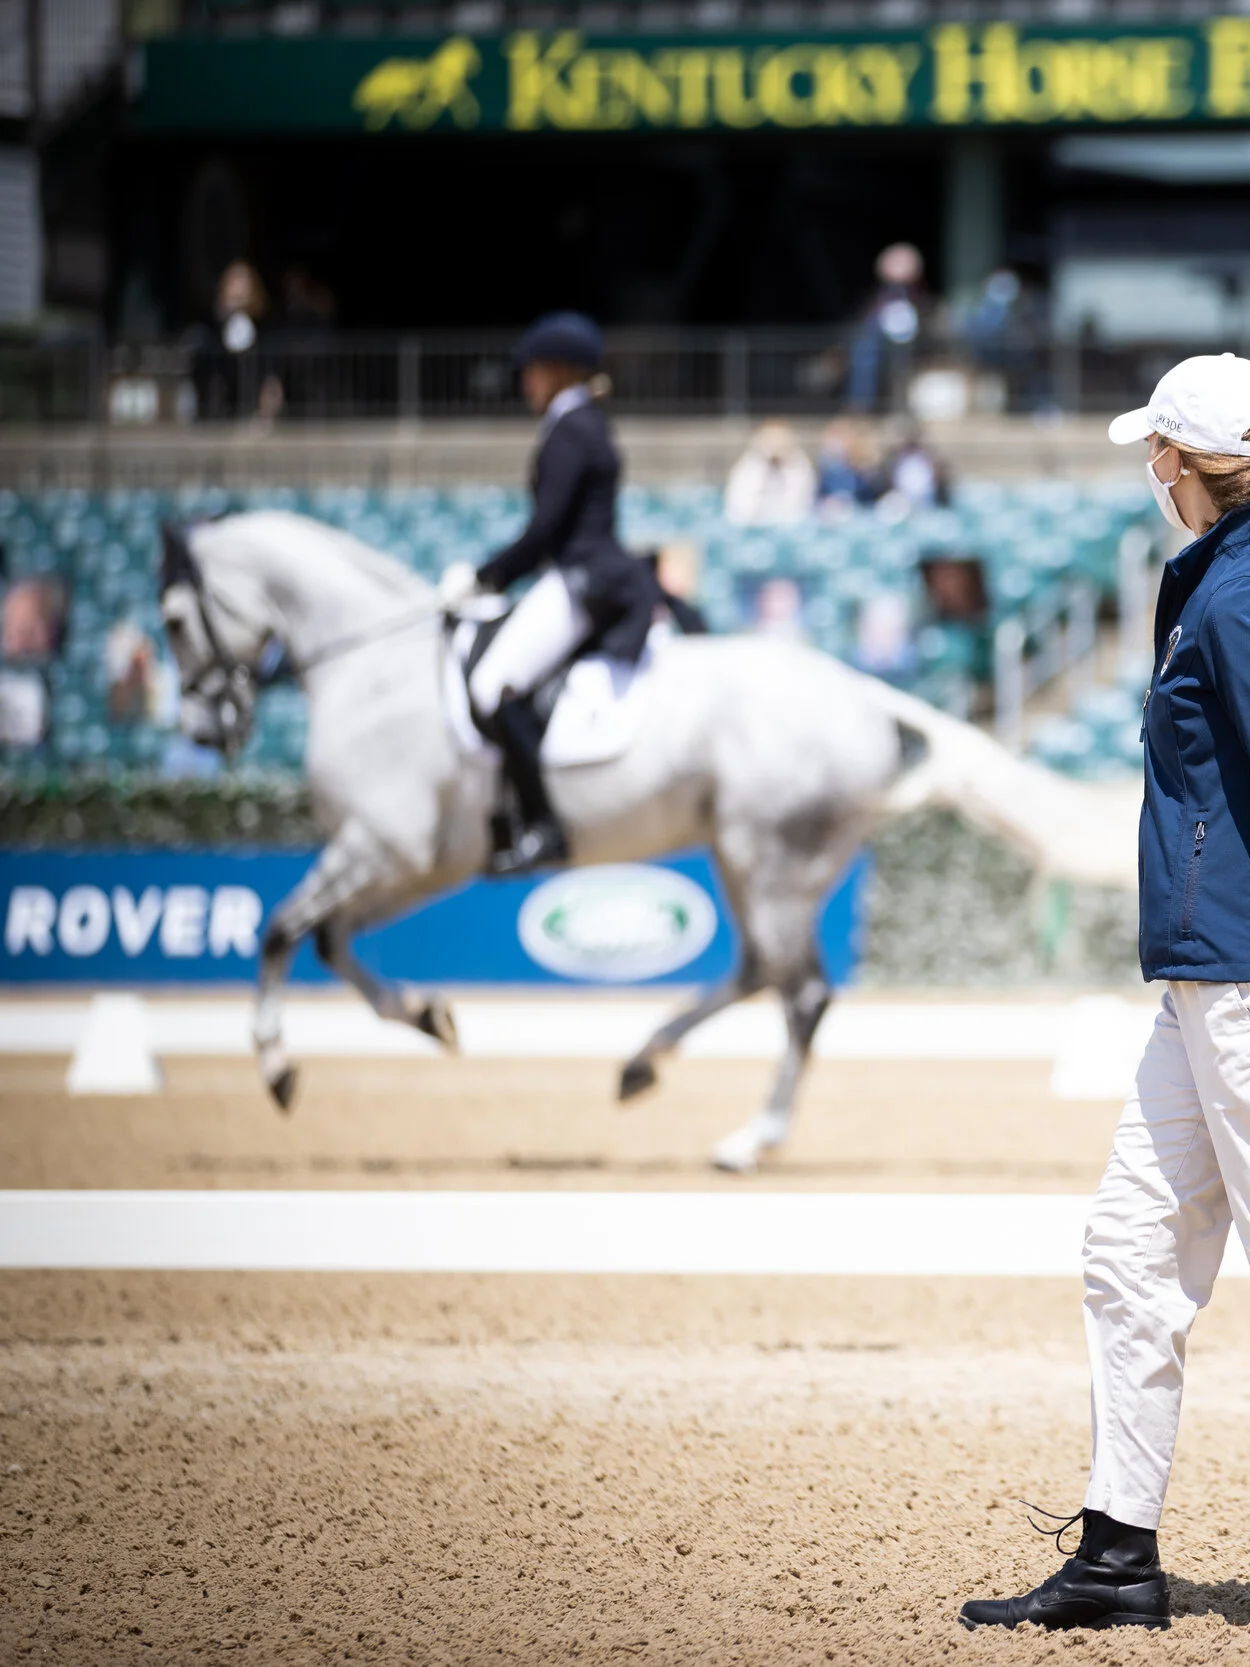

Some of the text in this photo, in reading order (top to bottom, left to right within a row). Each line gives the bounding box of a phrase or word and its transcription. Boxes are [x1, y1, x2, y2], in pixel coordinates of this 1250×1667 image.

[506, 30, 918, 130] KENTUCKY
[932, 22, 1194, 122] HORSE
[5, 885, 263, 958] ROVER
